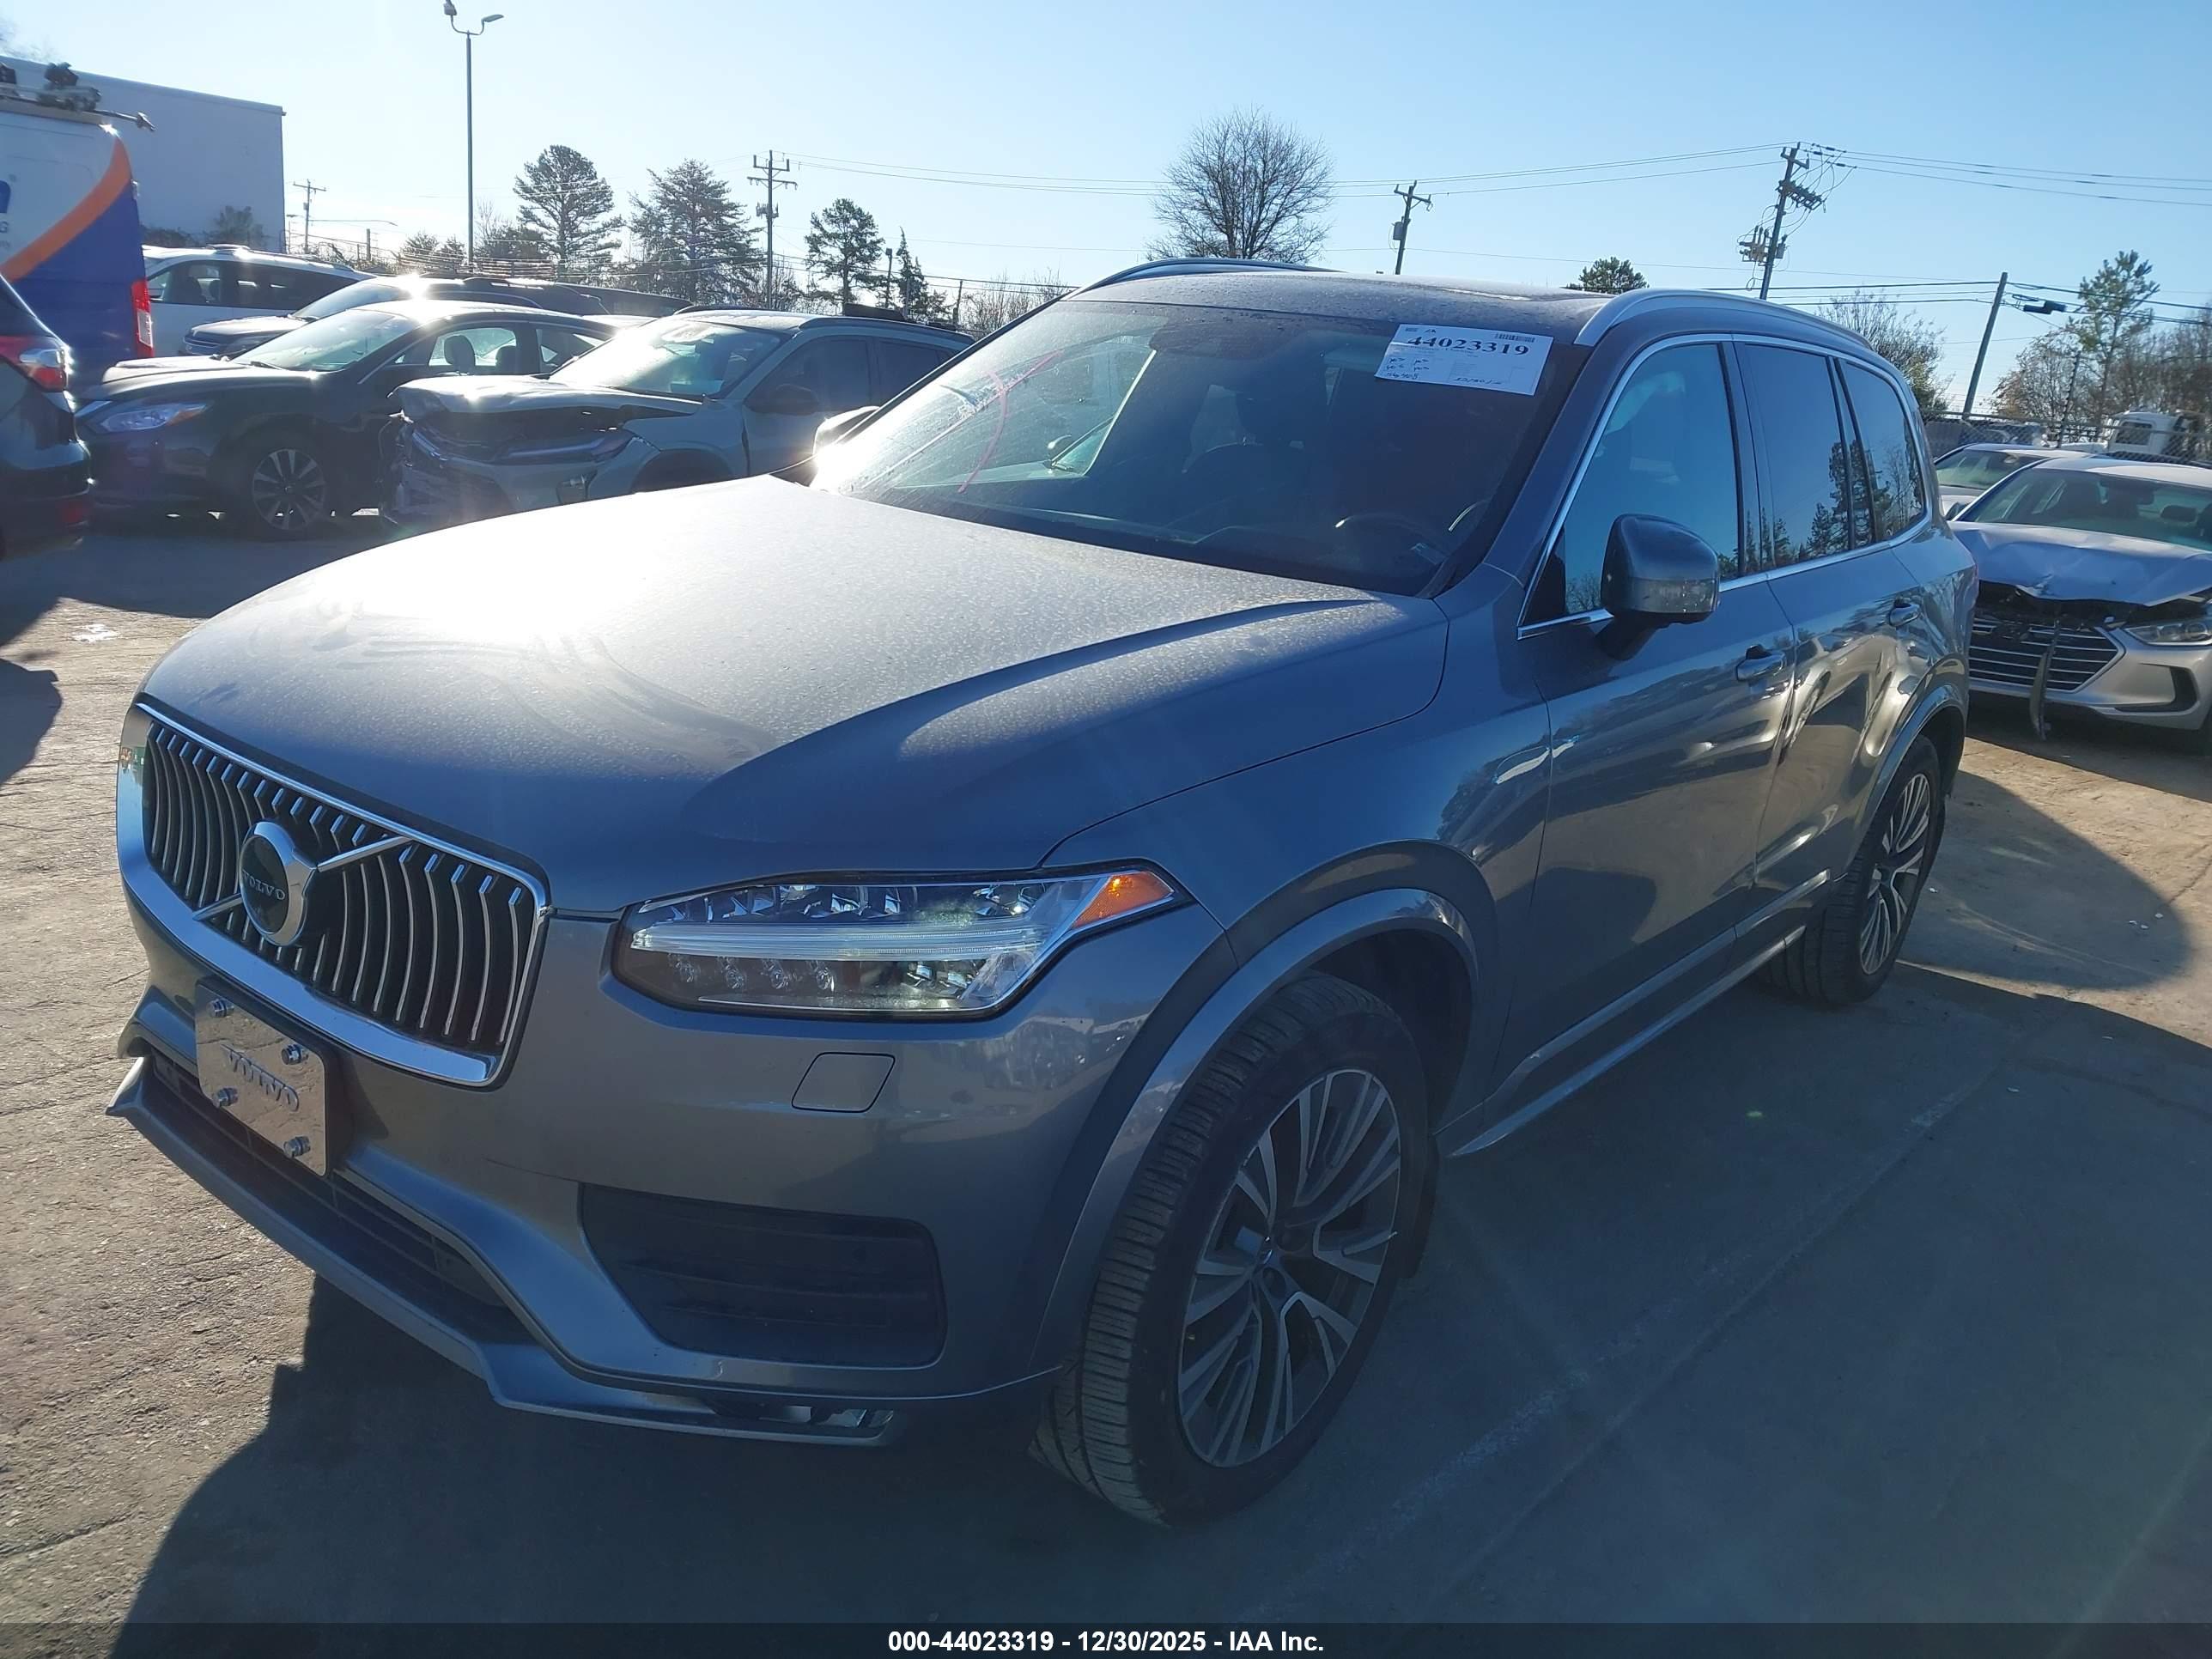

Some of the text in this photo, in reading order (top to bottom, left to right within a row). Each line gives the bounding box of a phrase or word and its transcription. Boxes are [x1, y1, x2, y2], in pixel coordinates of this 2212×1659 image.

[1407, 336, 1529, 356] 44023319
[241, 869, 286, 900] VOLVO
[222, 1044, 300, 1112] VOLVO
